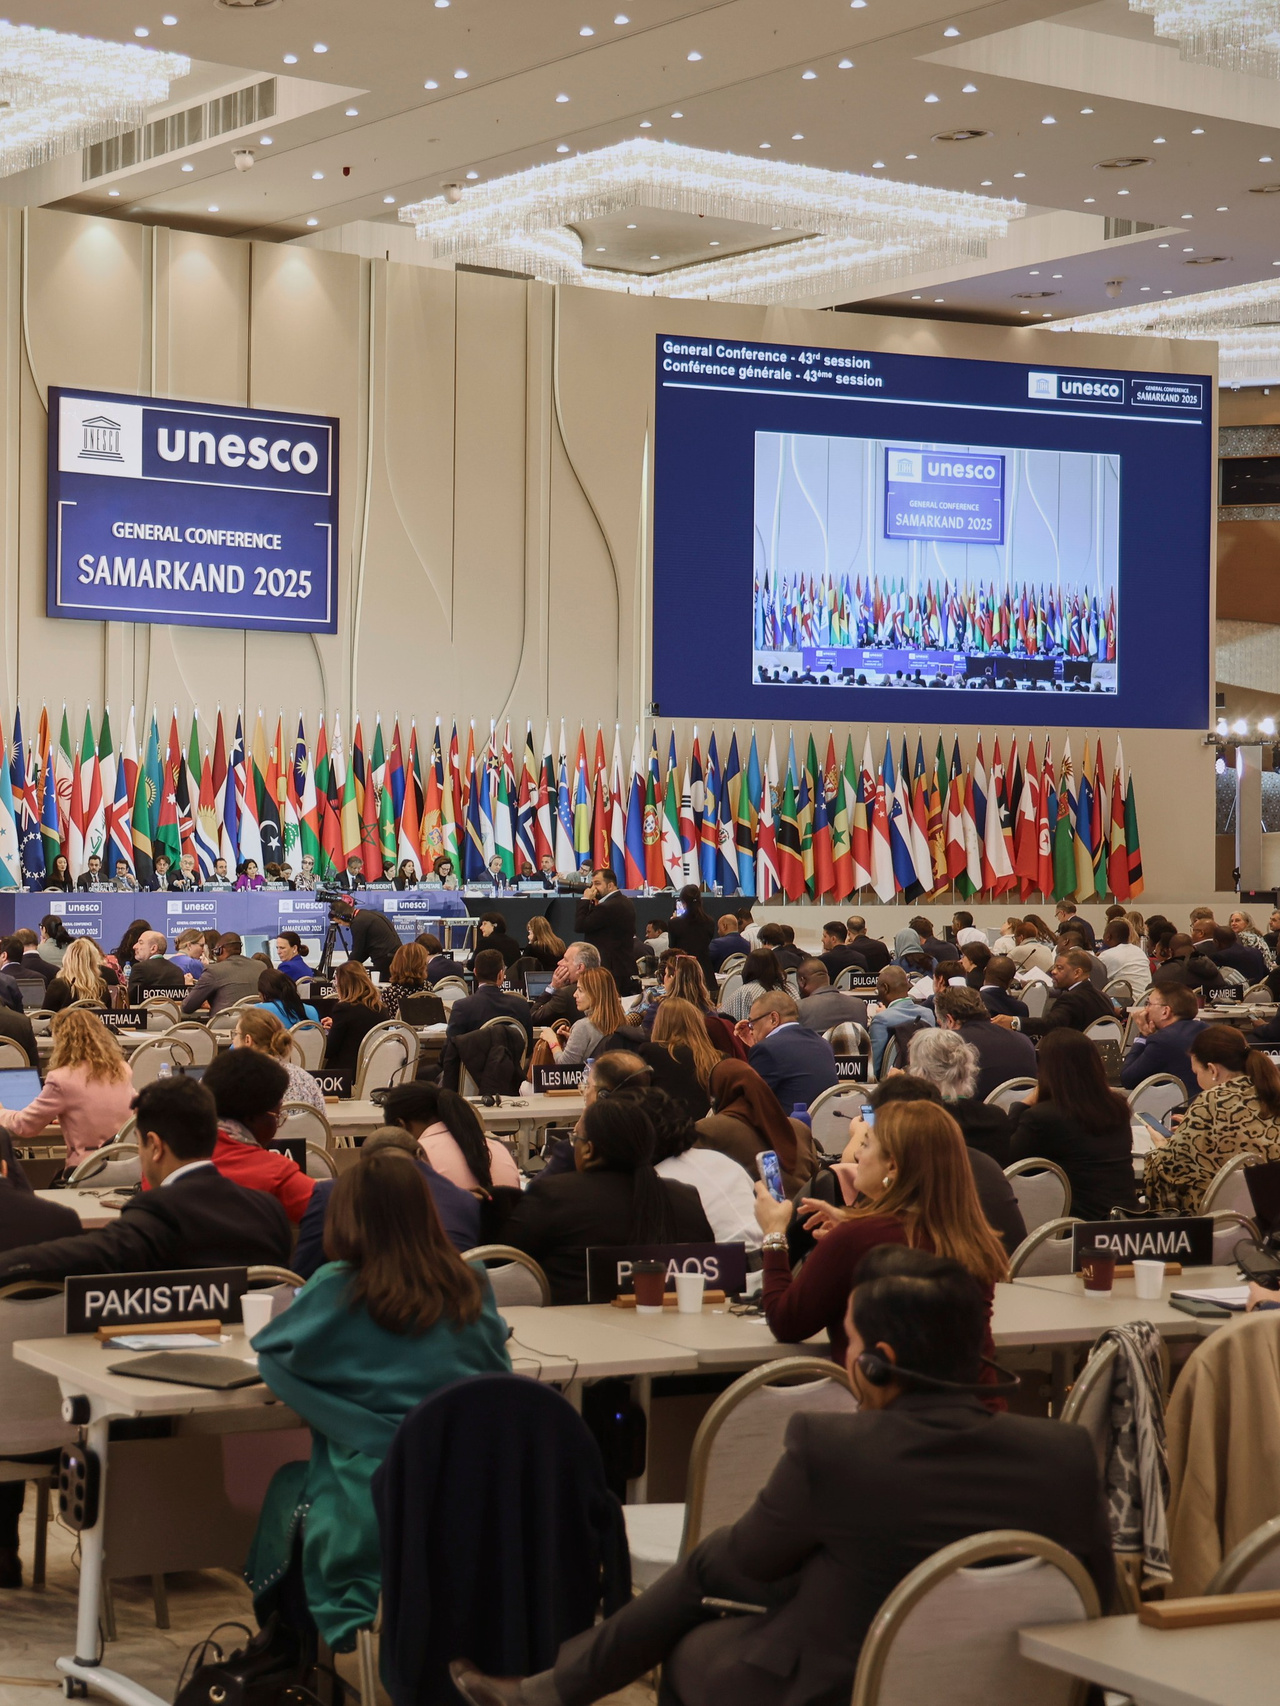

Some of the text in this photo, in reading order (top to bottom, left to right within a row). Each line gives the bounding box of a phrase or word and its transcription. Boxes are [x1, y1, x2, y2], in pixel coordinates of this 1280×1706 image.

[663, 341, 712, 357] General
[716, 345, 787, 363] Conference
[824, 356, 871, 370] session
[663, 359, 735, 376] Conférence
[739, 366, 792, 381] générale
[835, 373, 883, 388] session
[1062, 381, 1119, 398] unesco
[1137, 391, 1198, 404] SAMARKAND 2025
[158, 427, 318, 475] unesco
[927, 461, 996, 481] unesco
[909, 500, 980, 512] GENERAL CONFERENCE
[895, 513, 992, 531] SAMARKAND 2025
[111, 521, 282, 551] GENERAL CONFERENCE
[77, 553, 312, 599] SAMARKAND 2025
[68, 903, 100, 912] unesco
[184, 903, 214, 911] unesco
[294, 902, 323, 910] unesco
[399, 901, 427, 909] unesco
[143, 988, 190, 1001] BOTSWANA
[1208, 988, 1237, 999] GAMBIE
[96, 1013, 141, 1025] ATEMALA
[541, 1069, 561, 1086] ÎLES
[834, 1062, 861, 1076] OMON
[315, 1076, 343, 1091] OOK
[1095, 1230, 1192, 1257] PANAMA
[616, 1256, 719, 1286] PAOS
[85, 1282, 229, 1318] PAKISTAN
